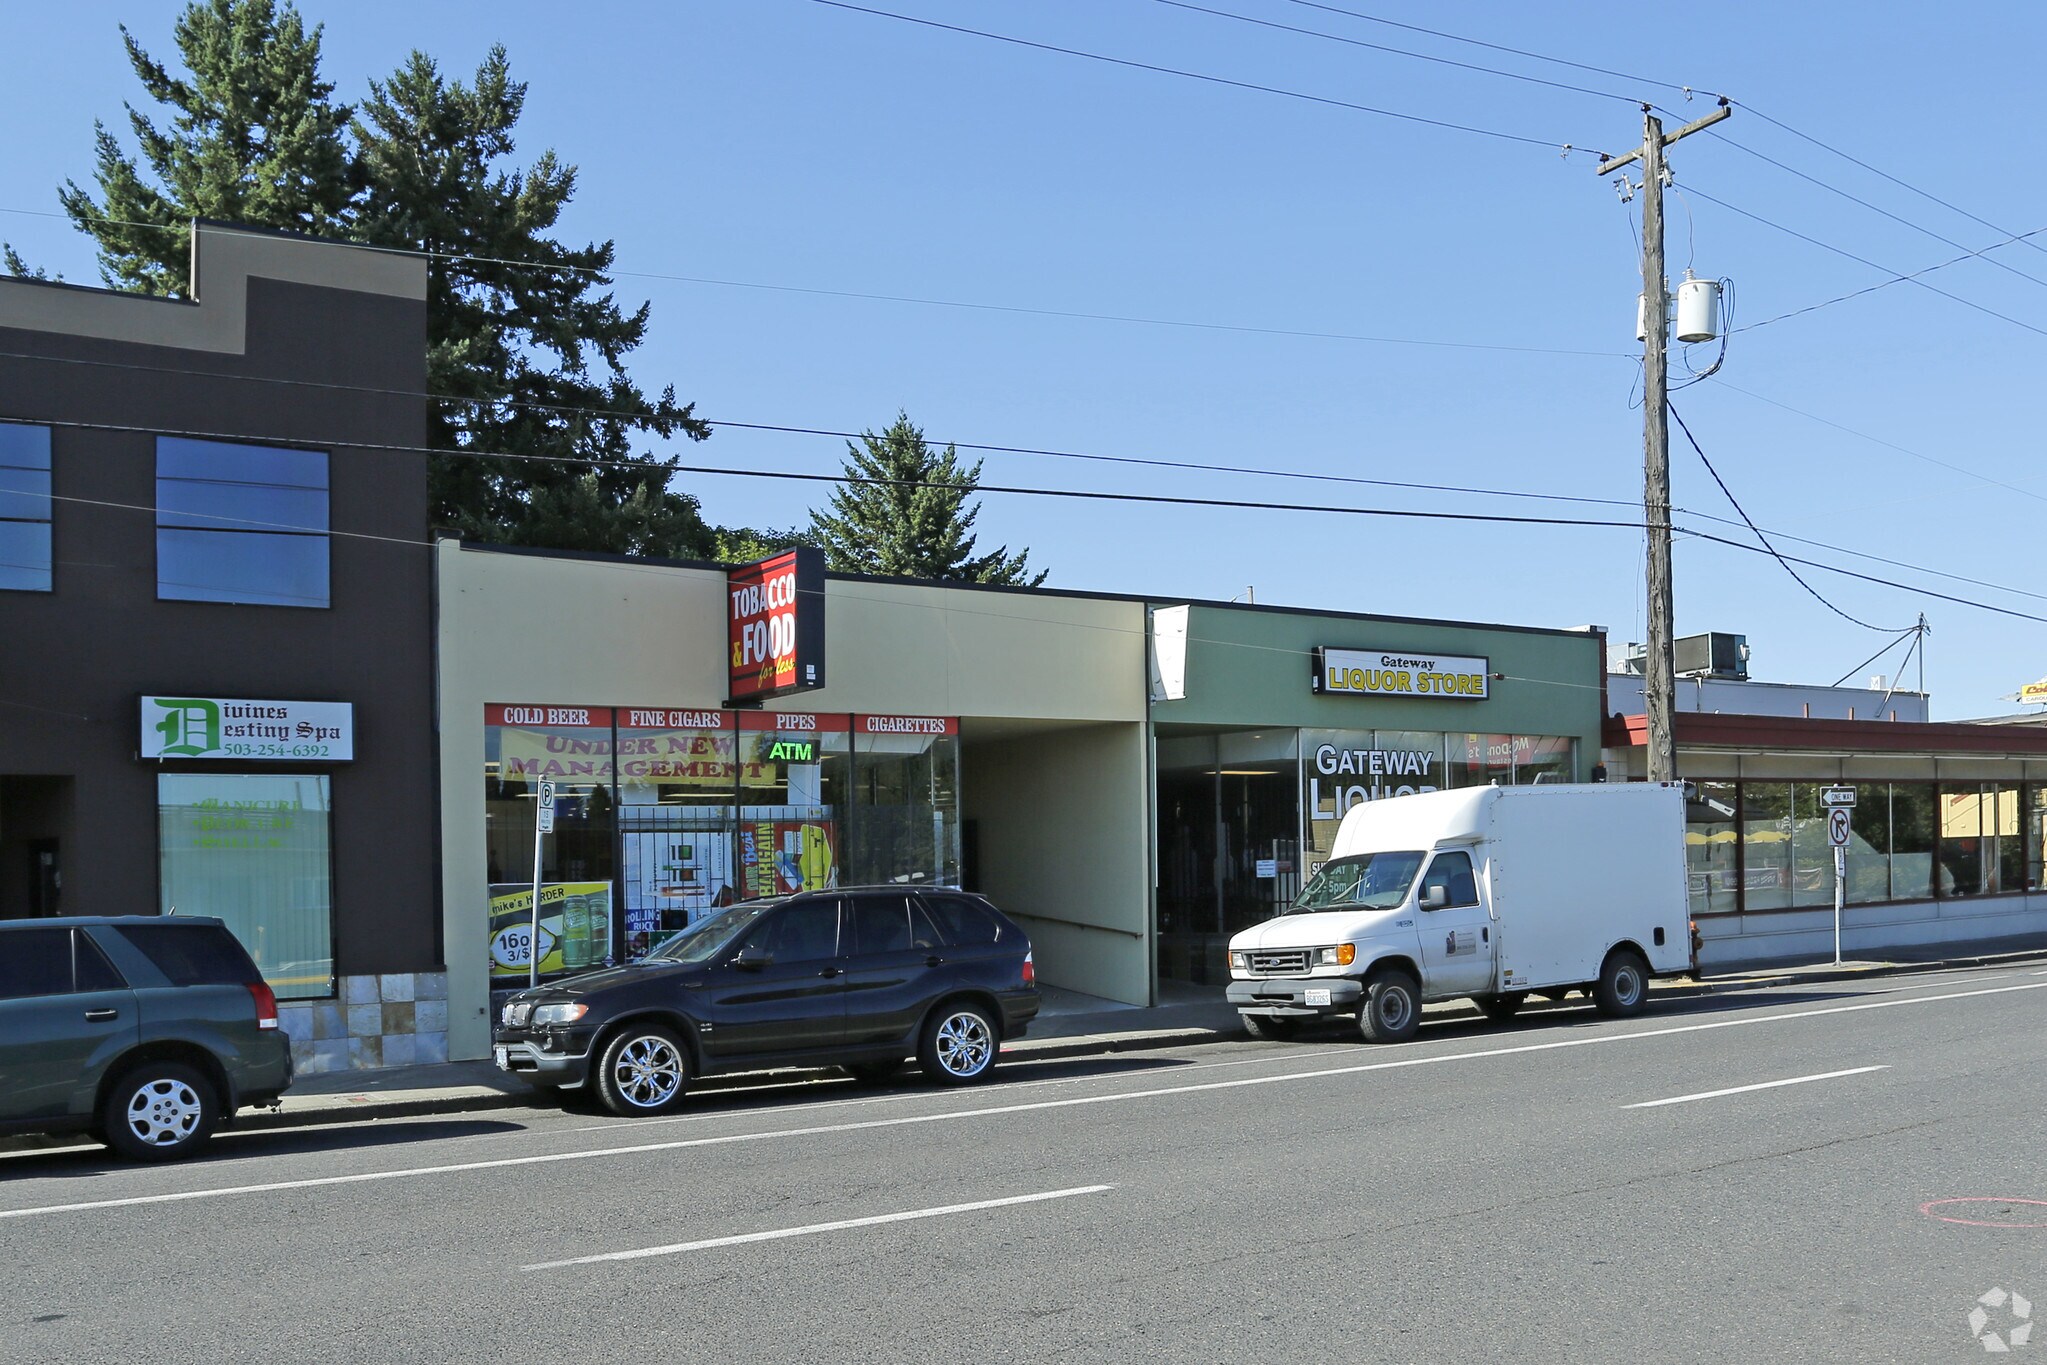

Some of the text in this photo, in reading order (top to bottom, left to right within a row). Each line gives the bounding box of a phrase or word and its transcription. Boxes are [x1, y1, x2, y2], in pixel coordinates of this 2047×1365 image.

[732, 572, 796, 620] TOBACCO
[732, 612, 796, 668] & FOOD
[758, 662, 774, 689] for
[775, 655, 795, 676] less
[1381, 655, 1436, 671] Gateway
[1328, 667, 1484, 695] LIQUOR STORE
[503, 707, 590, 726] COLD BEER
[630, 710, 721, 728] FINE CIGARS
[776, 714, 816, 730] PIPES
[866, 717, 946, 733] CIGARETTES
[295, 721, 341, 742] Spa
[223, 743, 330, 757] 503-254-6392
[545, 735, 735, 756] UNDER NEW
[769, 742, 812, 760] ATM
[509, 757, 766, 779] MANAGEMENT
[1315, 744, 1434, 776] GATEWAY
[1310, 778, 1438, 820] LIQ
[1831, 792, 1853, 802] ONE WAY
[756, 822, 776, 897] BARGAIN
[1328, 881, 1348, 895] 5pm
[492, 888, 565, 914] mike's HRDER
[633, 921, 656, 932] ROCK
